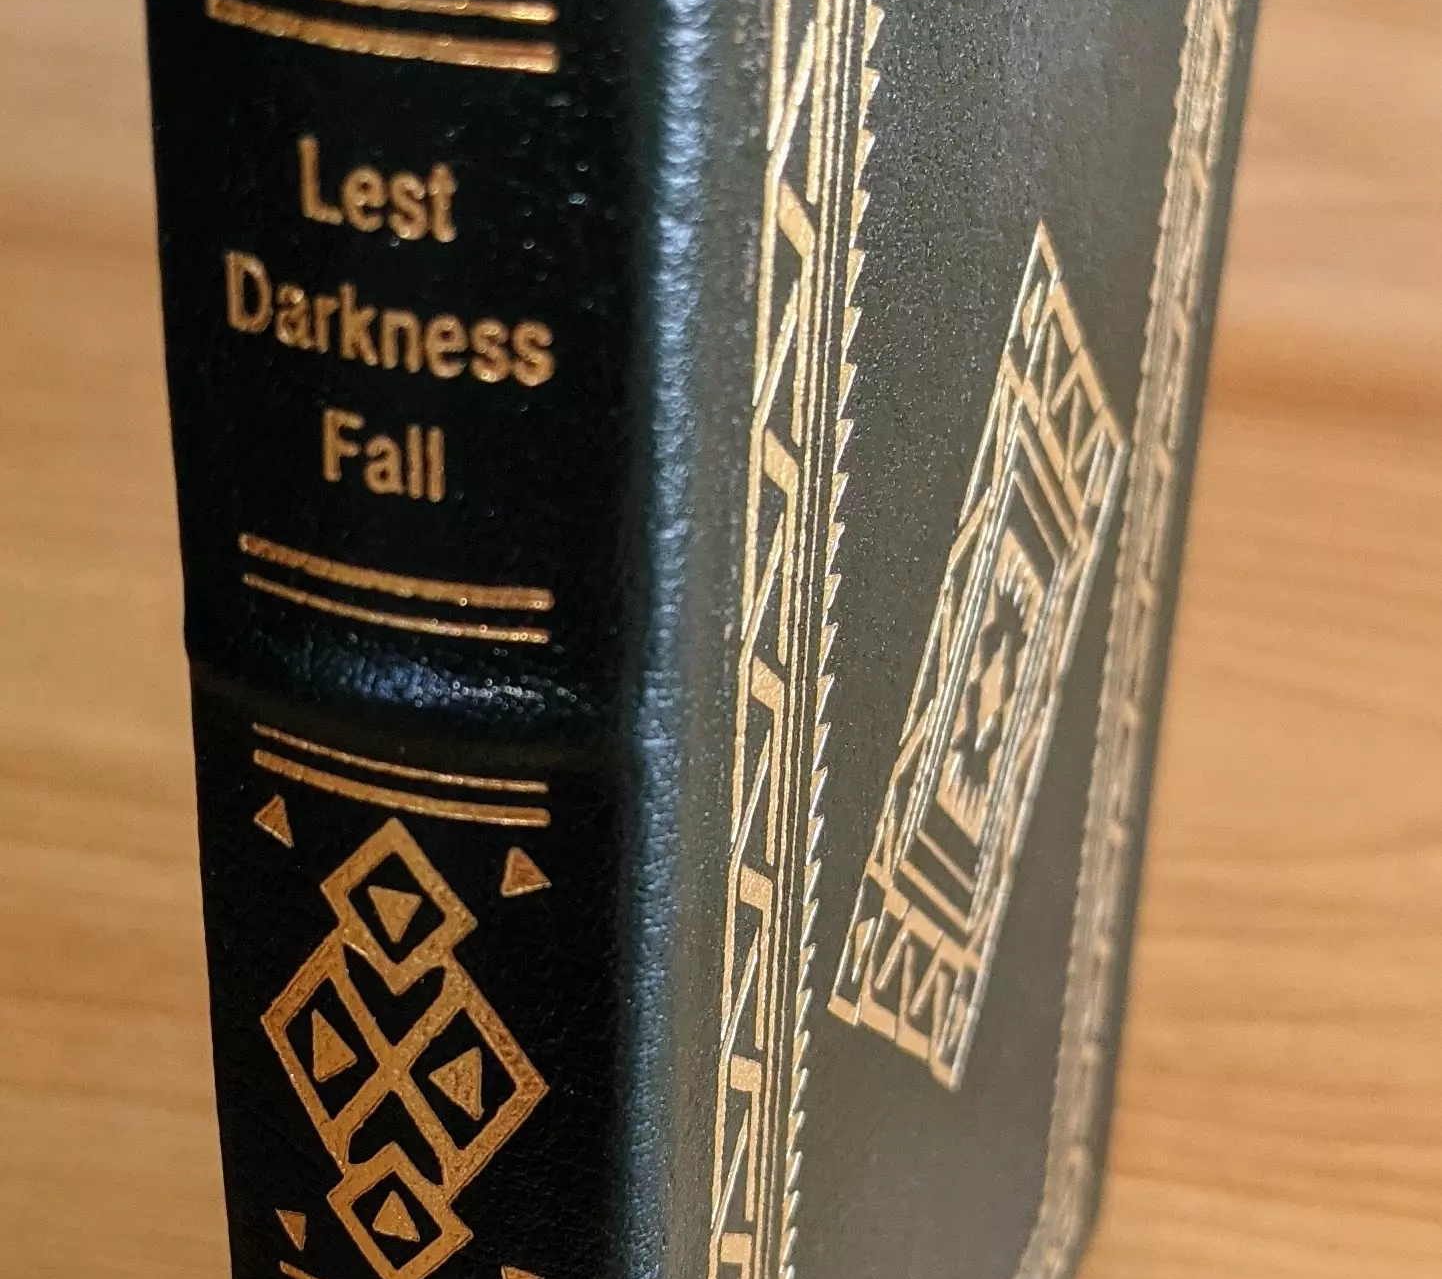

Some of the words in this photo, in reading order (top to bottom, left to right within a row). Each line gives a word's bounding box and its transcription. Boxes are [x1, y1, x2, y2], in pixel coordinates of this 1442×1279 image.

[298, 134, 459, 243] Lest
[225, 250, 557, 386] Darkness
[322, 408, 445, 503] Fall
